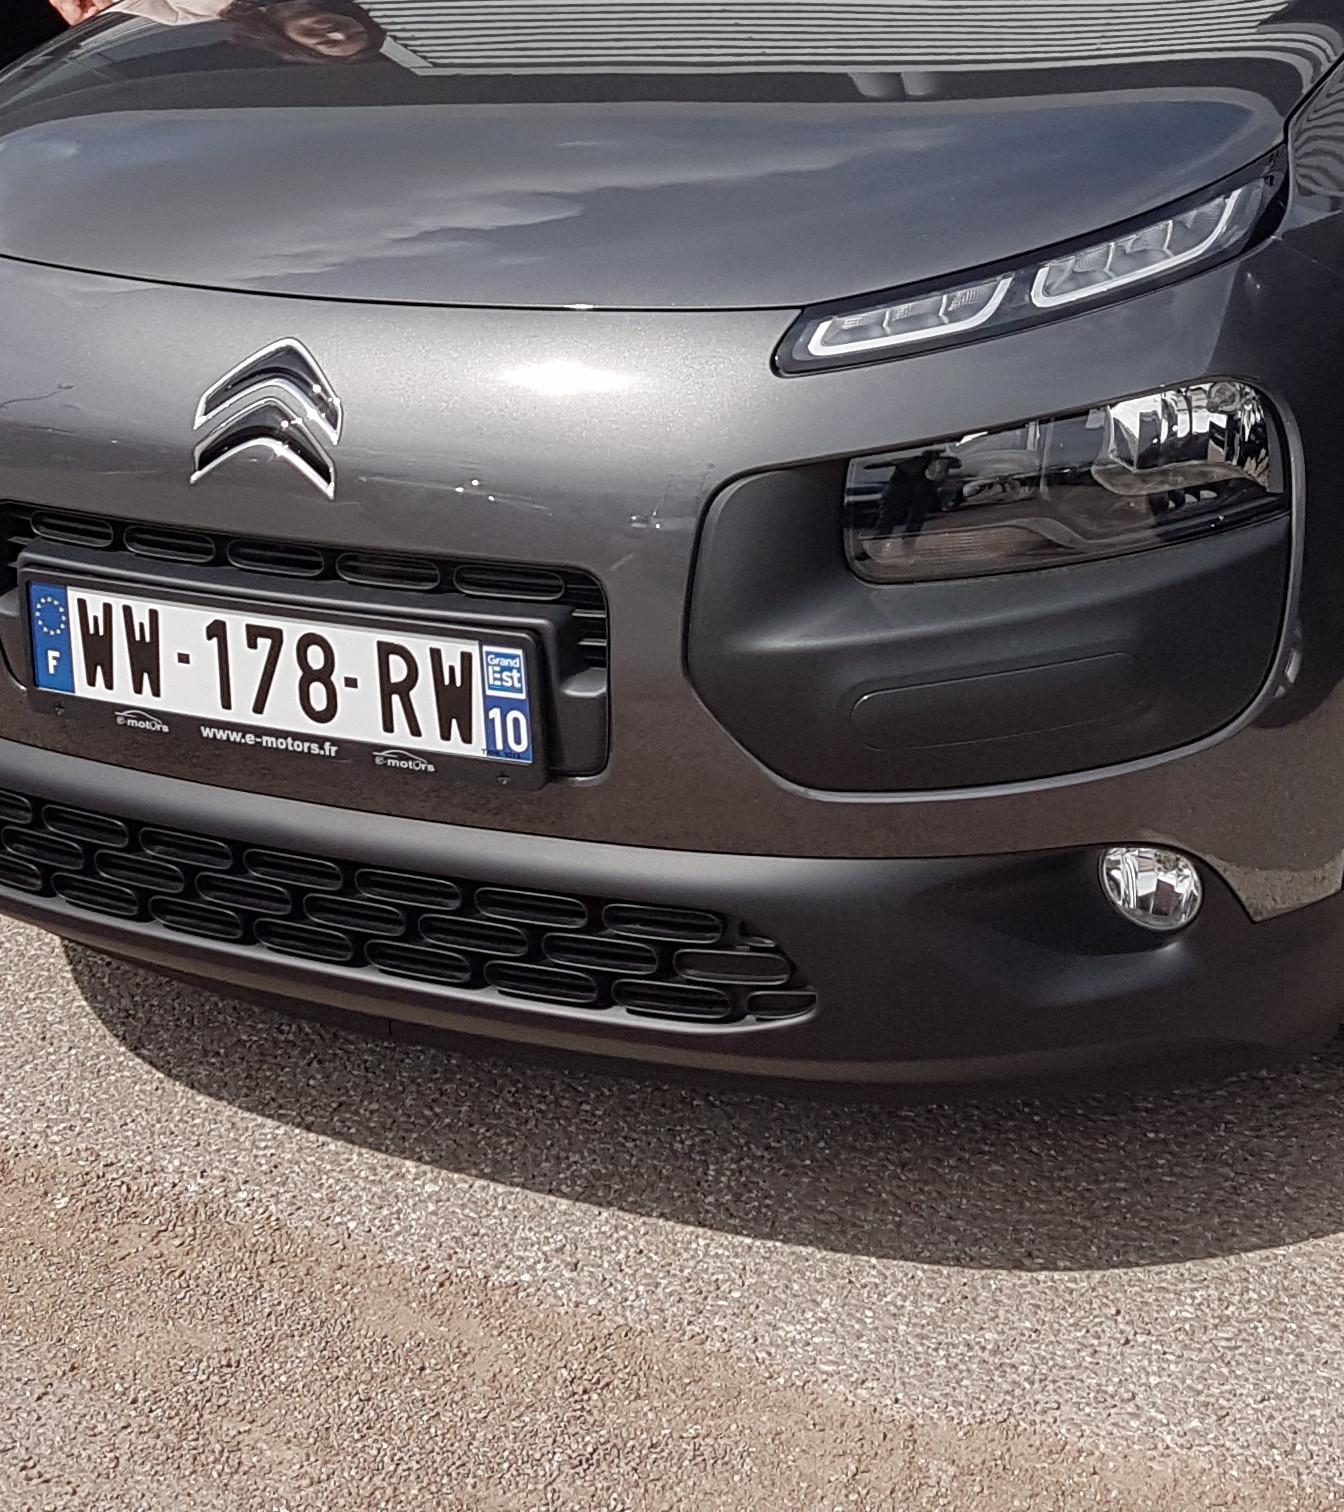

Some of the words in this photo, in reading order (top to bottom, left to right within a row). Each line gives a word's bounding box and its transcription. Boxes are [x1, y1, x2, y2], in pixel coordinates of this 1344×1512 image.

[47, 650, 61, 675] F
[76, 597, 473, 745] WW-178-RW
[487, 654, 520, 668] Grand
[488, 666, 522, 689] Est
[200, 725, 339, 757] www.e-motors.fr
[488, 707, 529, 753] 10
